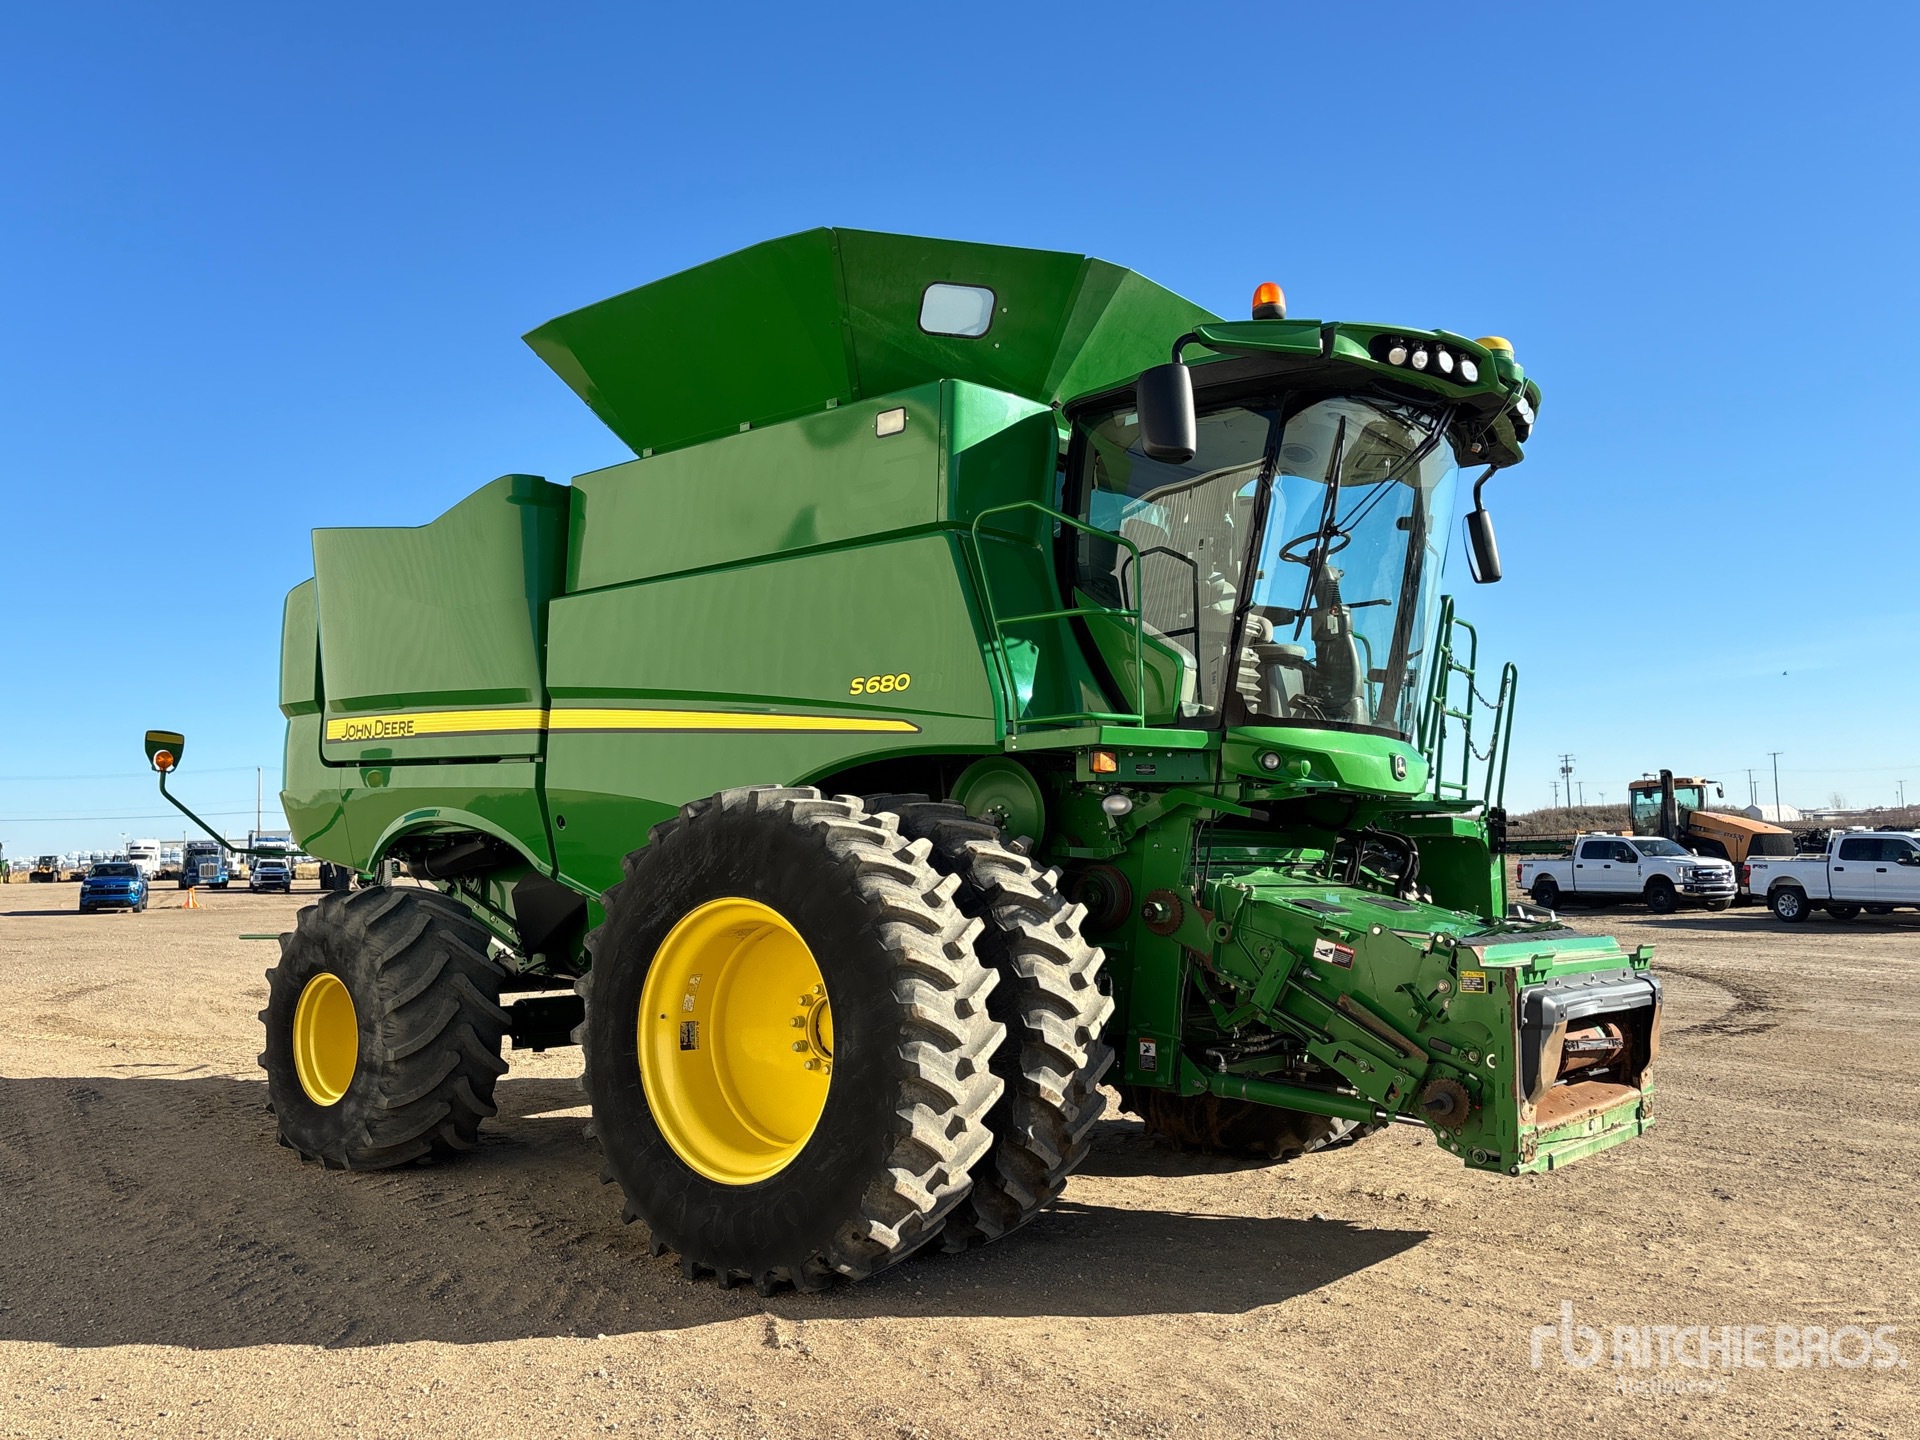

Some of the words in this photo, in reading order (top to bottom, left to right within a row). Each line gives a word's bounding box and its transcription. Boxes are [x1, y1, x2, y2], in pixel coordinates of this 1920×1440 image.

[849, 672, 911, 696] S680
[341, 722, 372, 739] JOHN
[374, 719, 415, 736] DEERE
